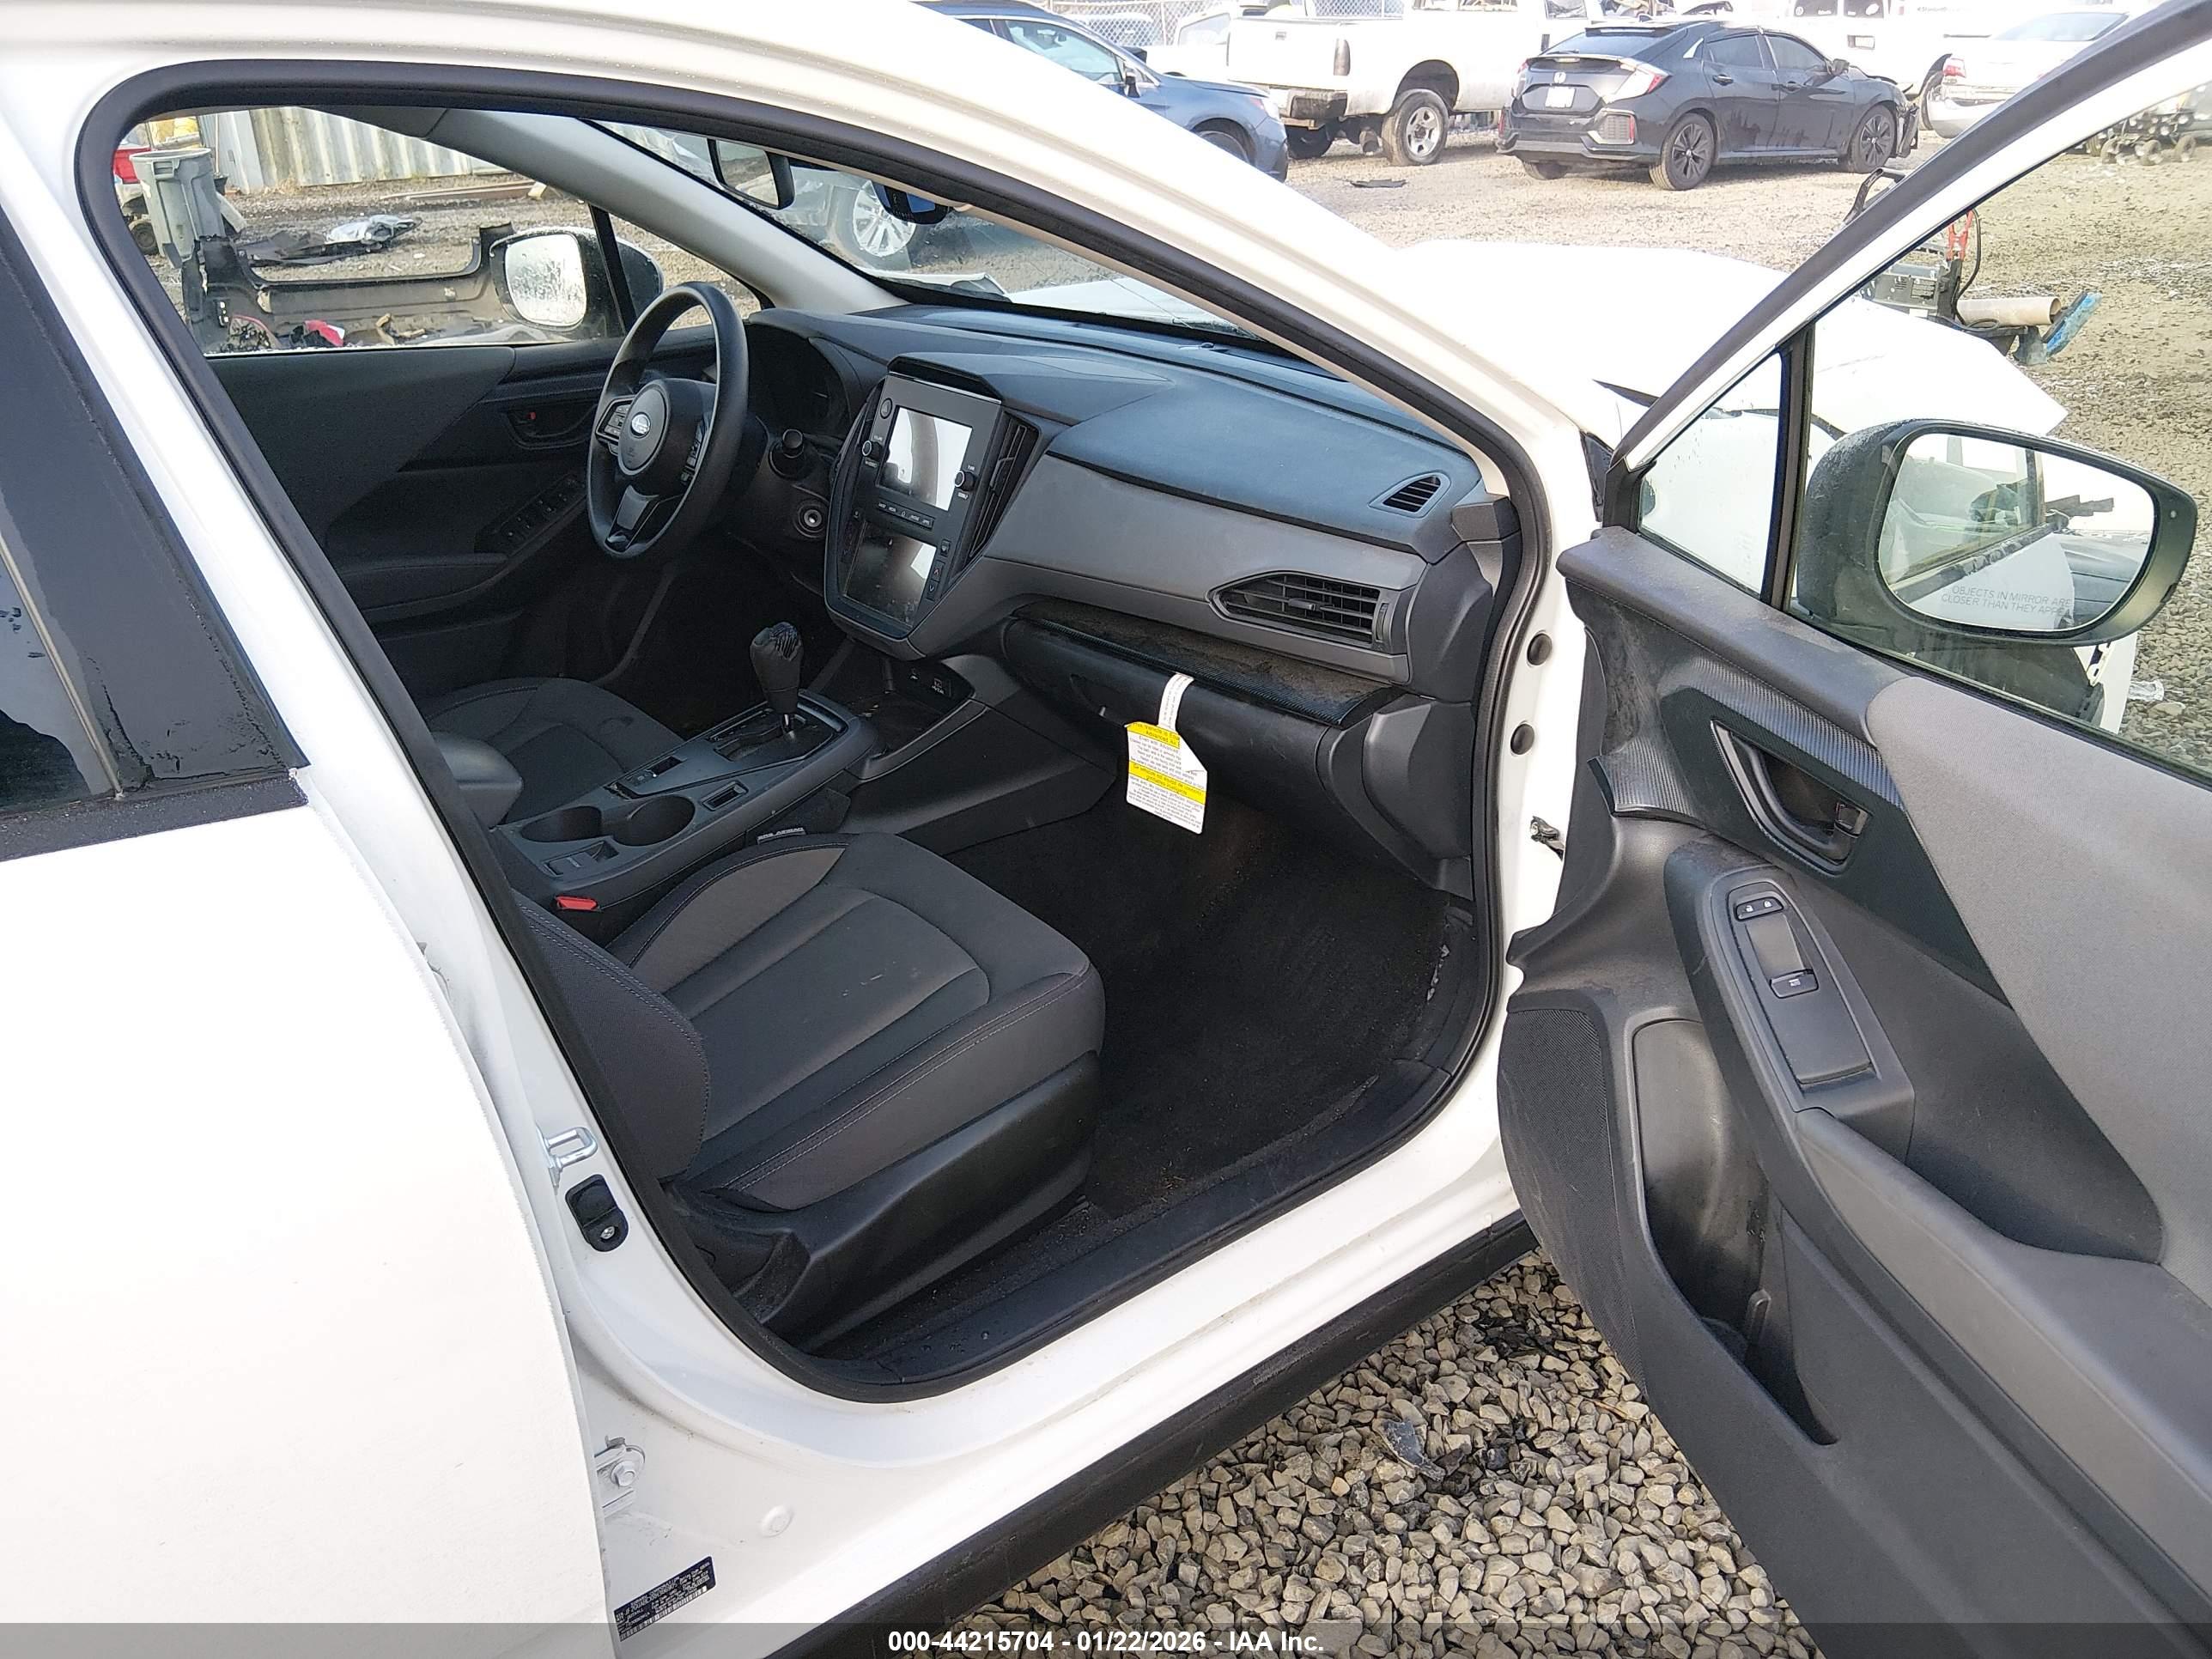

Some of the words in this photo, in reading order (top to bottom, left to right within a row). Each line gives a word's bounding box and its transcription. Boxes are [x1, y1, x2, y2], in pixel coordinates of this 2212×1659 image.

[1942, 593, 1980, 605] CLOSER
[1983, 599, 2008, 610] THAN
[2012, 603, 2038, 613] THEY
[1952, 586, 1995, 599] OBJECTS
[1997, 591, 2009, 600] IN
[2009, 592, 2049, 605] MIRROR
[2051, 598, 2074, 608] ARE
